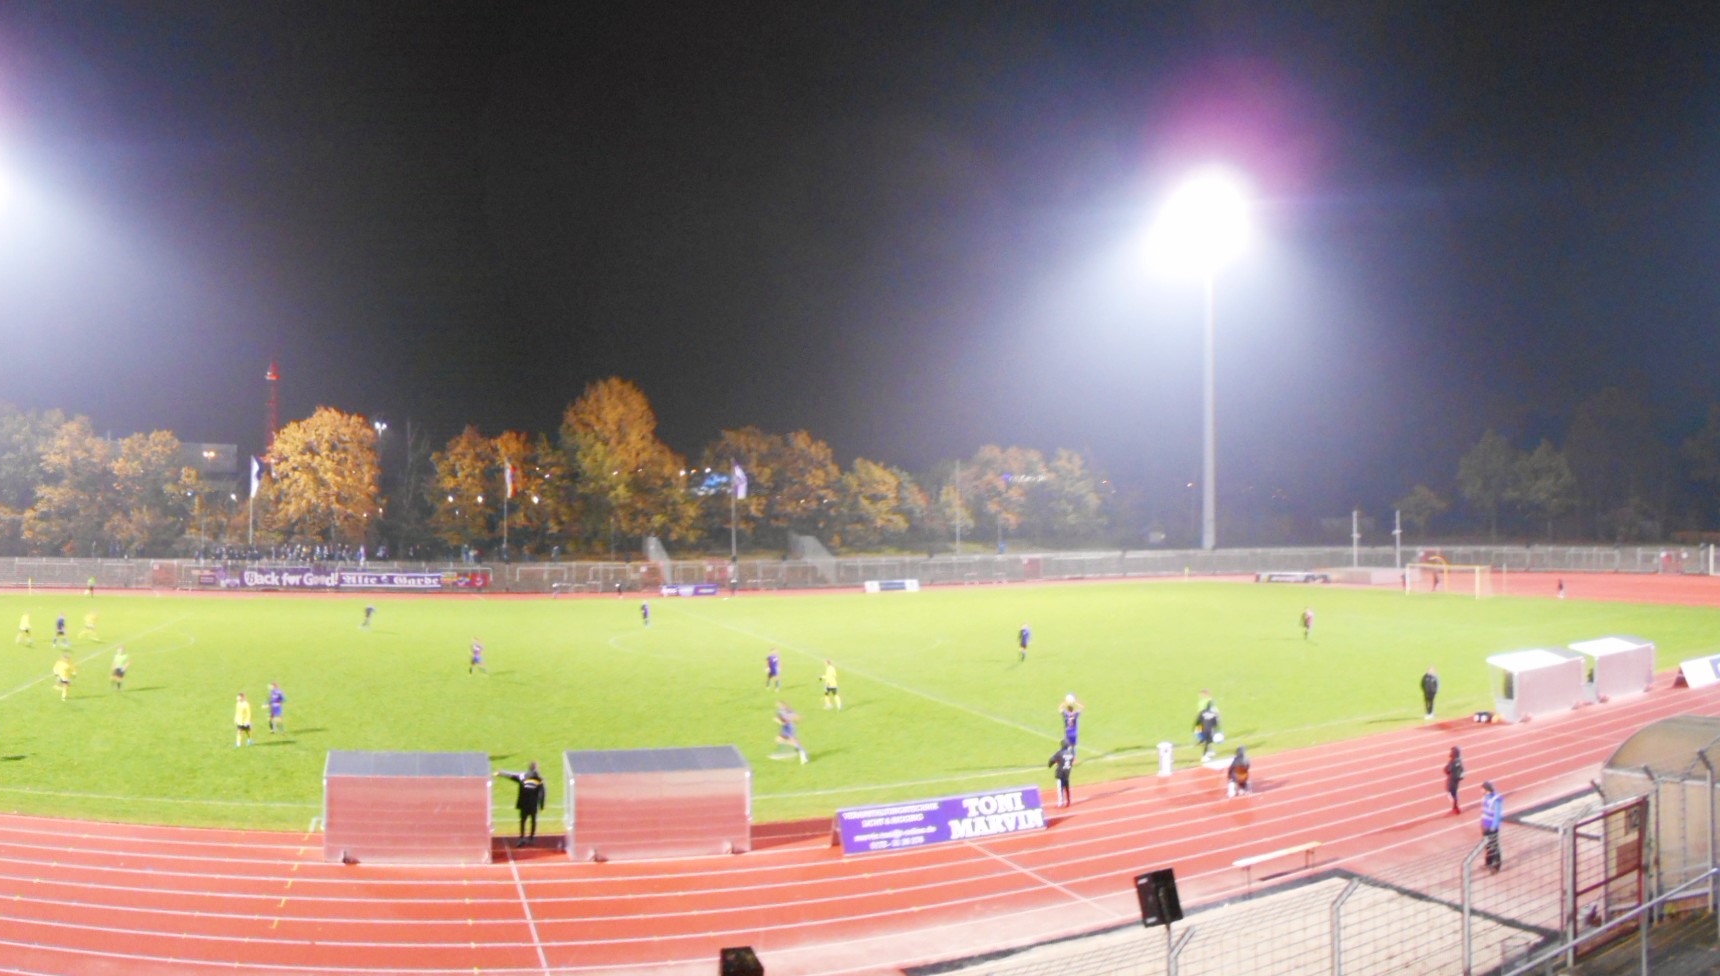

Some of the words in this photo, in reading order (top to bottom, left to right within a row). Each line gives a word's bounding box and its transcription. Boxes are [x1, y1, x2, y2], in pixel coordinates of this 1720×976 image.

[244, 571, 279, 586] Back
[281, 572, 301, 585] for
[962, 792, 1025, 818] TONI
[948, 808, 1044, 839] MARVIN
